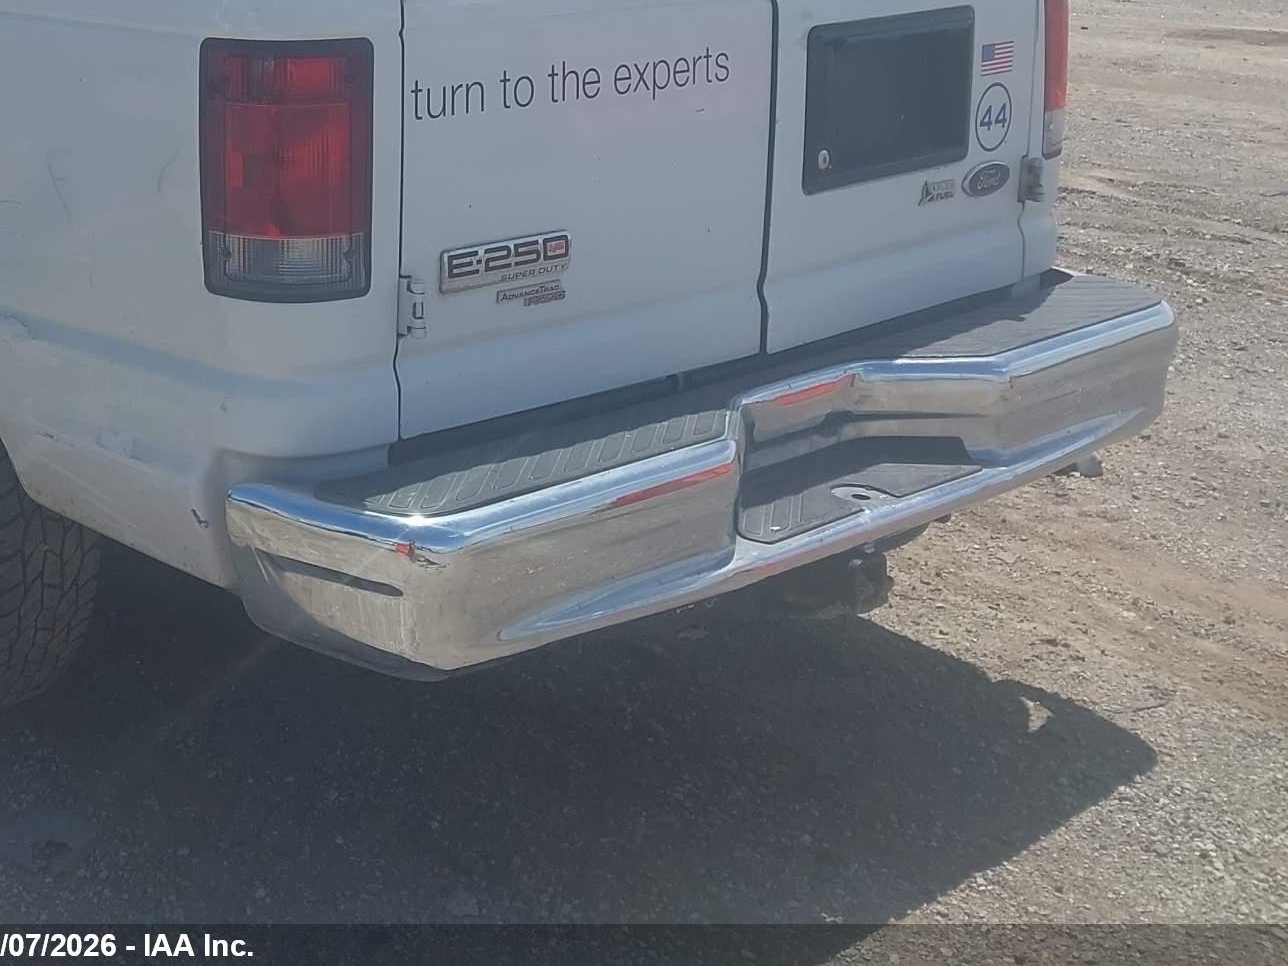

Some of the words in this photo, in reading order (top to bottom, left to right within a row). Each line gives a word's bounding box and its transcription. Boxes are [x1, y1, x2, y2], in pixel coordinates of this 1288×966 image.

[411, 79, 485, 121] turn
[499, 69, 535, 109] to
[548, 60, 601, 103] the
[614, 46, 730, 101] experts
[978, 102, 1008, 131] 44
[447, 234, 570, 279] E-250
[499, 267, 537, 282] SUPER
[538, 263, 568, 275] DUTY
